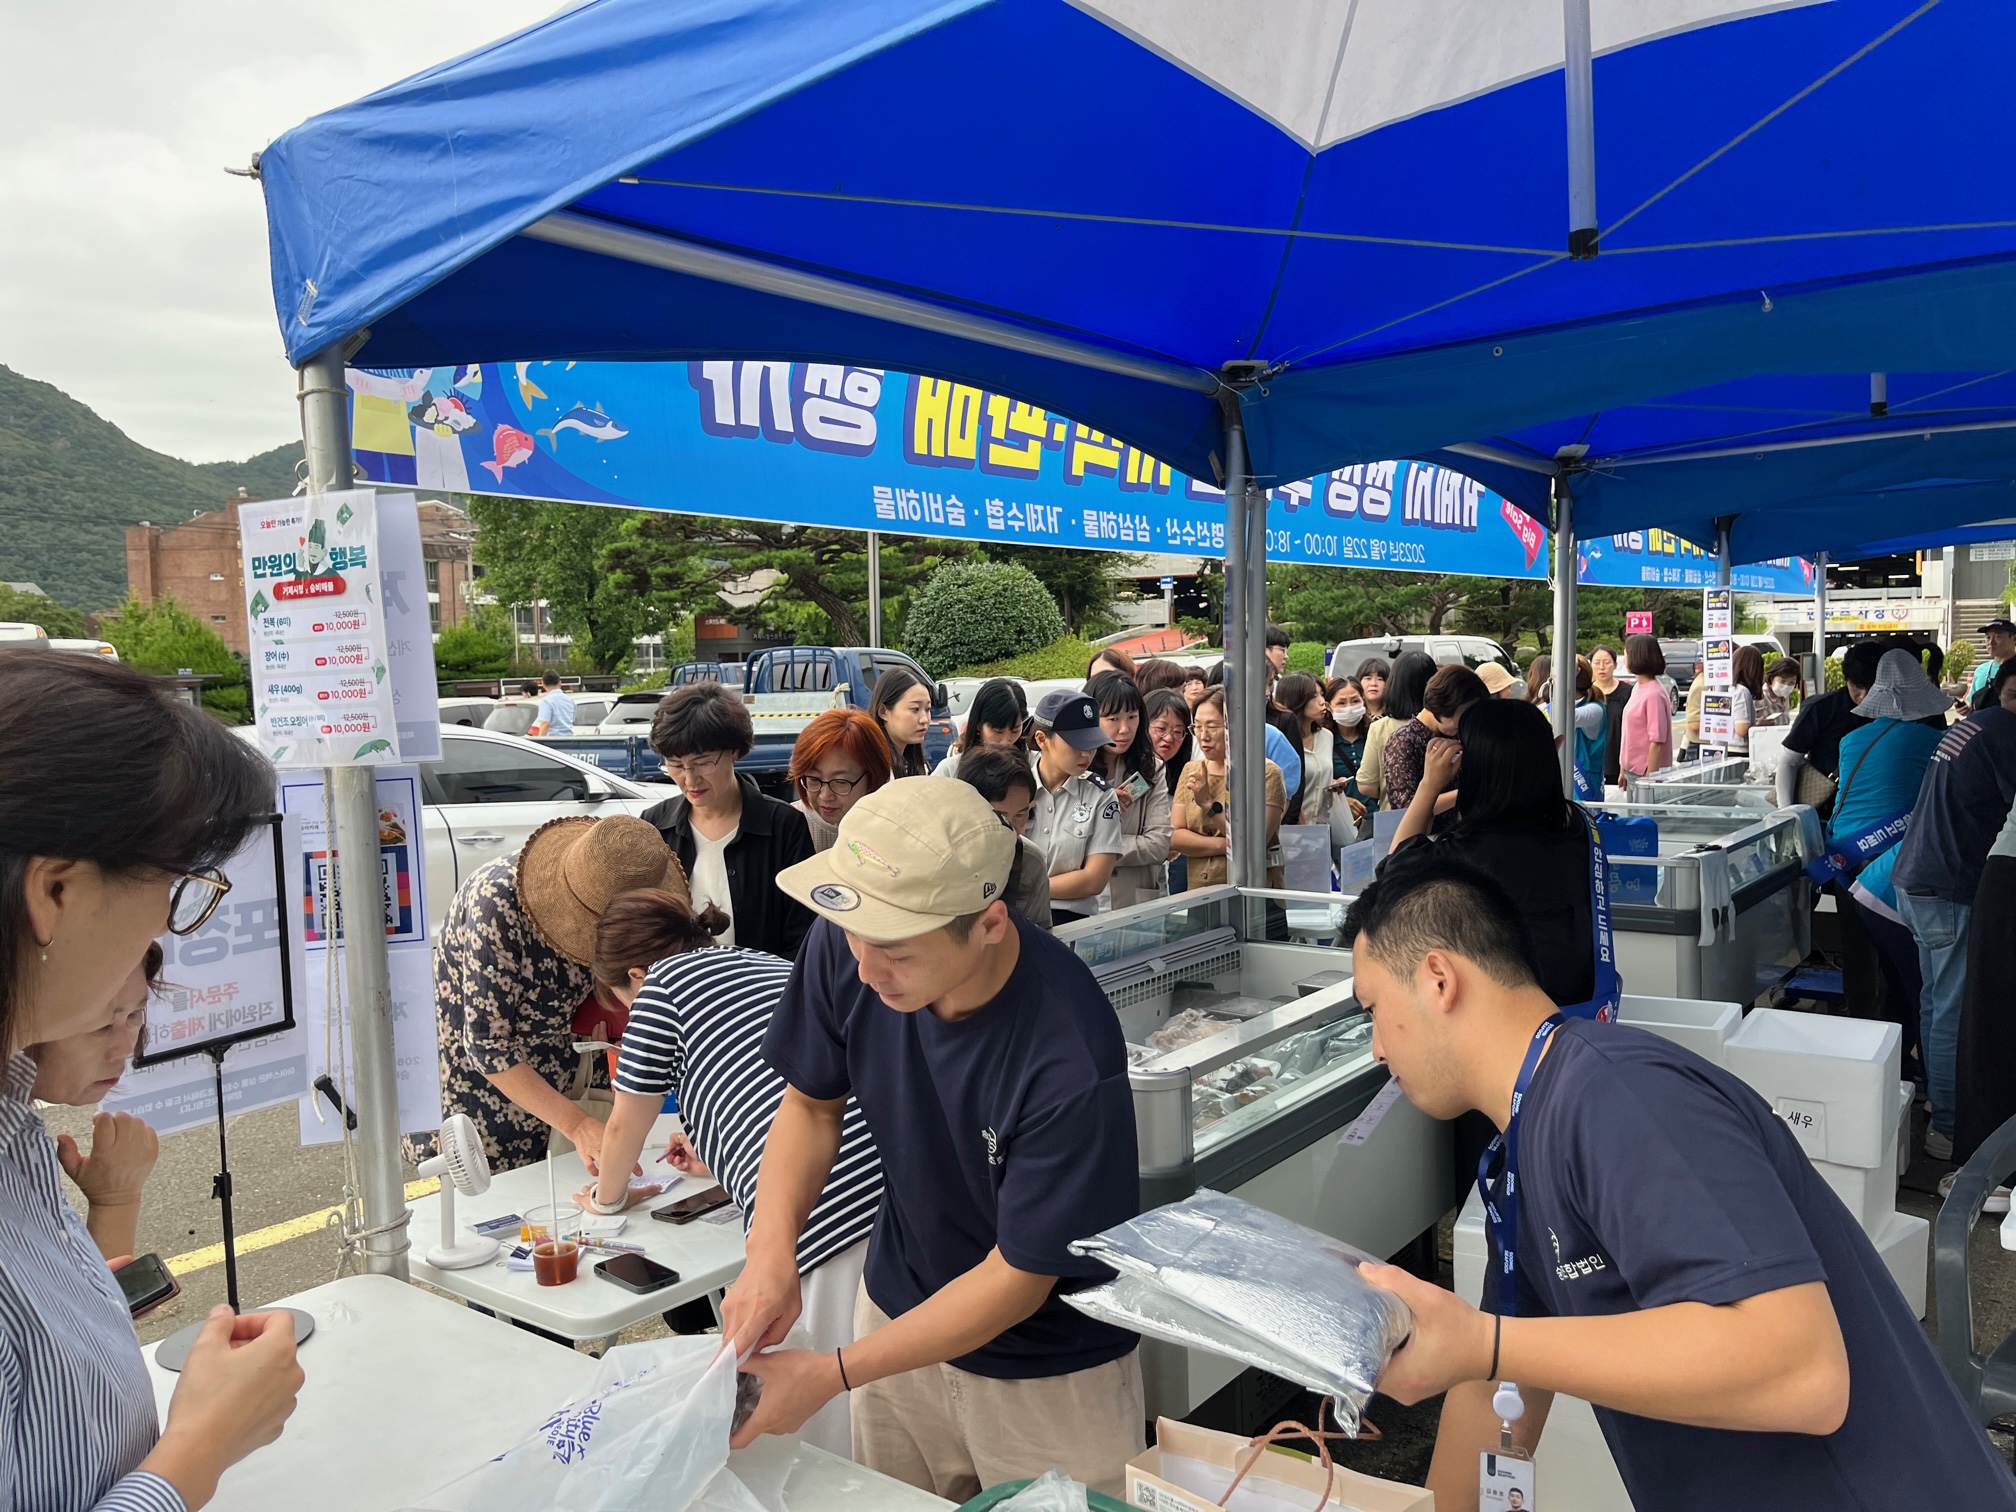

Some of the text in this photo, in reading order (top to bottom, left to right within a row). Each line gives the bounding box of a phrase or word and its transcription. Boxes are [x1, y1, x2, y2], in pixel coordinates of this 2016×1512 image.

[252, 552, 297, 579] 만원의
[329, 545, 368, 571] 행복
[263, 617, 276, 629] 전복
[325, 619, 360, 632] 10,000원
[1630, 617, 1640, 628] P
[328, 653, 363, 666] 10,000원
[280, 684, 303, 695] (400g)
[330, 688, 366, 700] 10,000원
[333, 721, 371, 734] 10,000원
[1787, 1110, 1814, 1129] 새우
[579, 1402, 602, 1443] Blue
